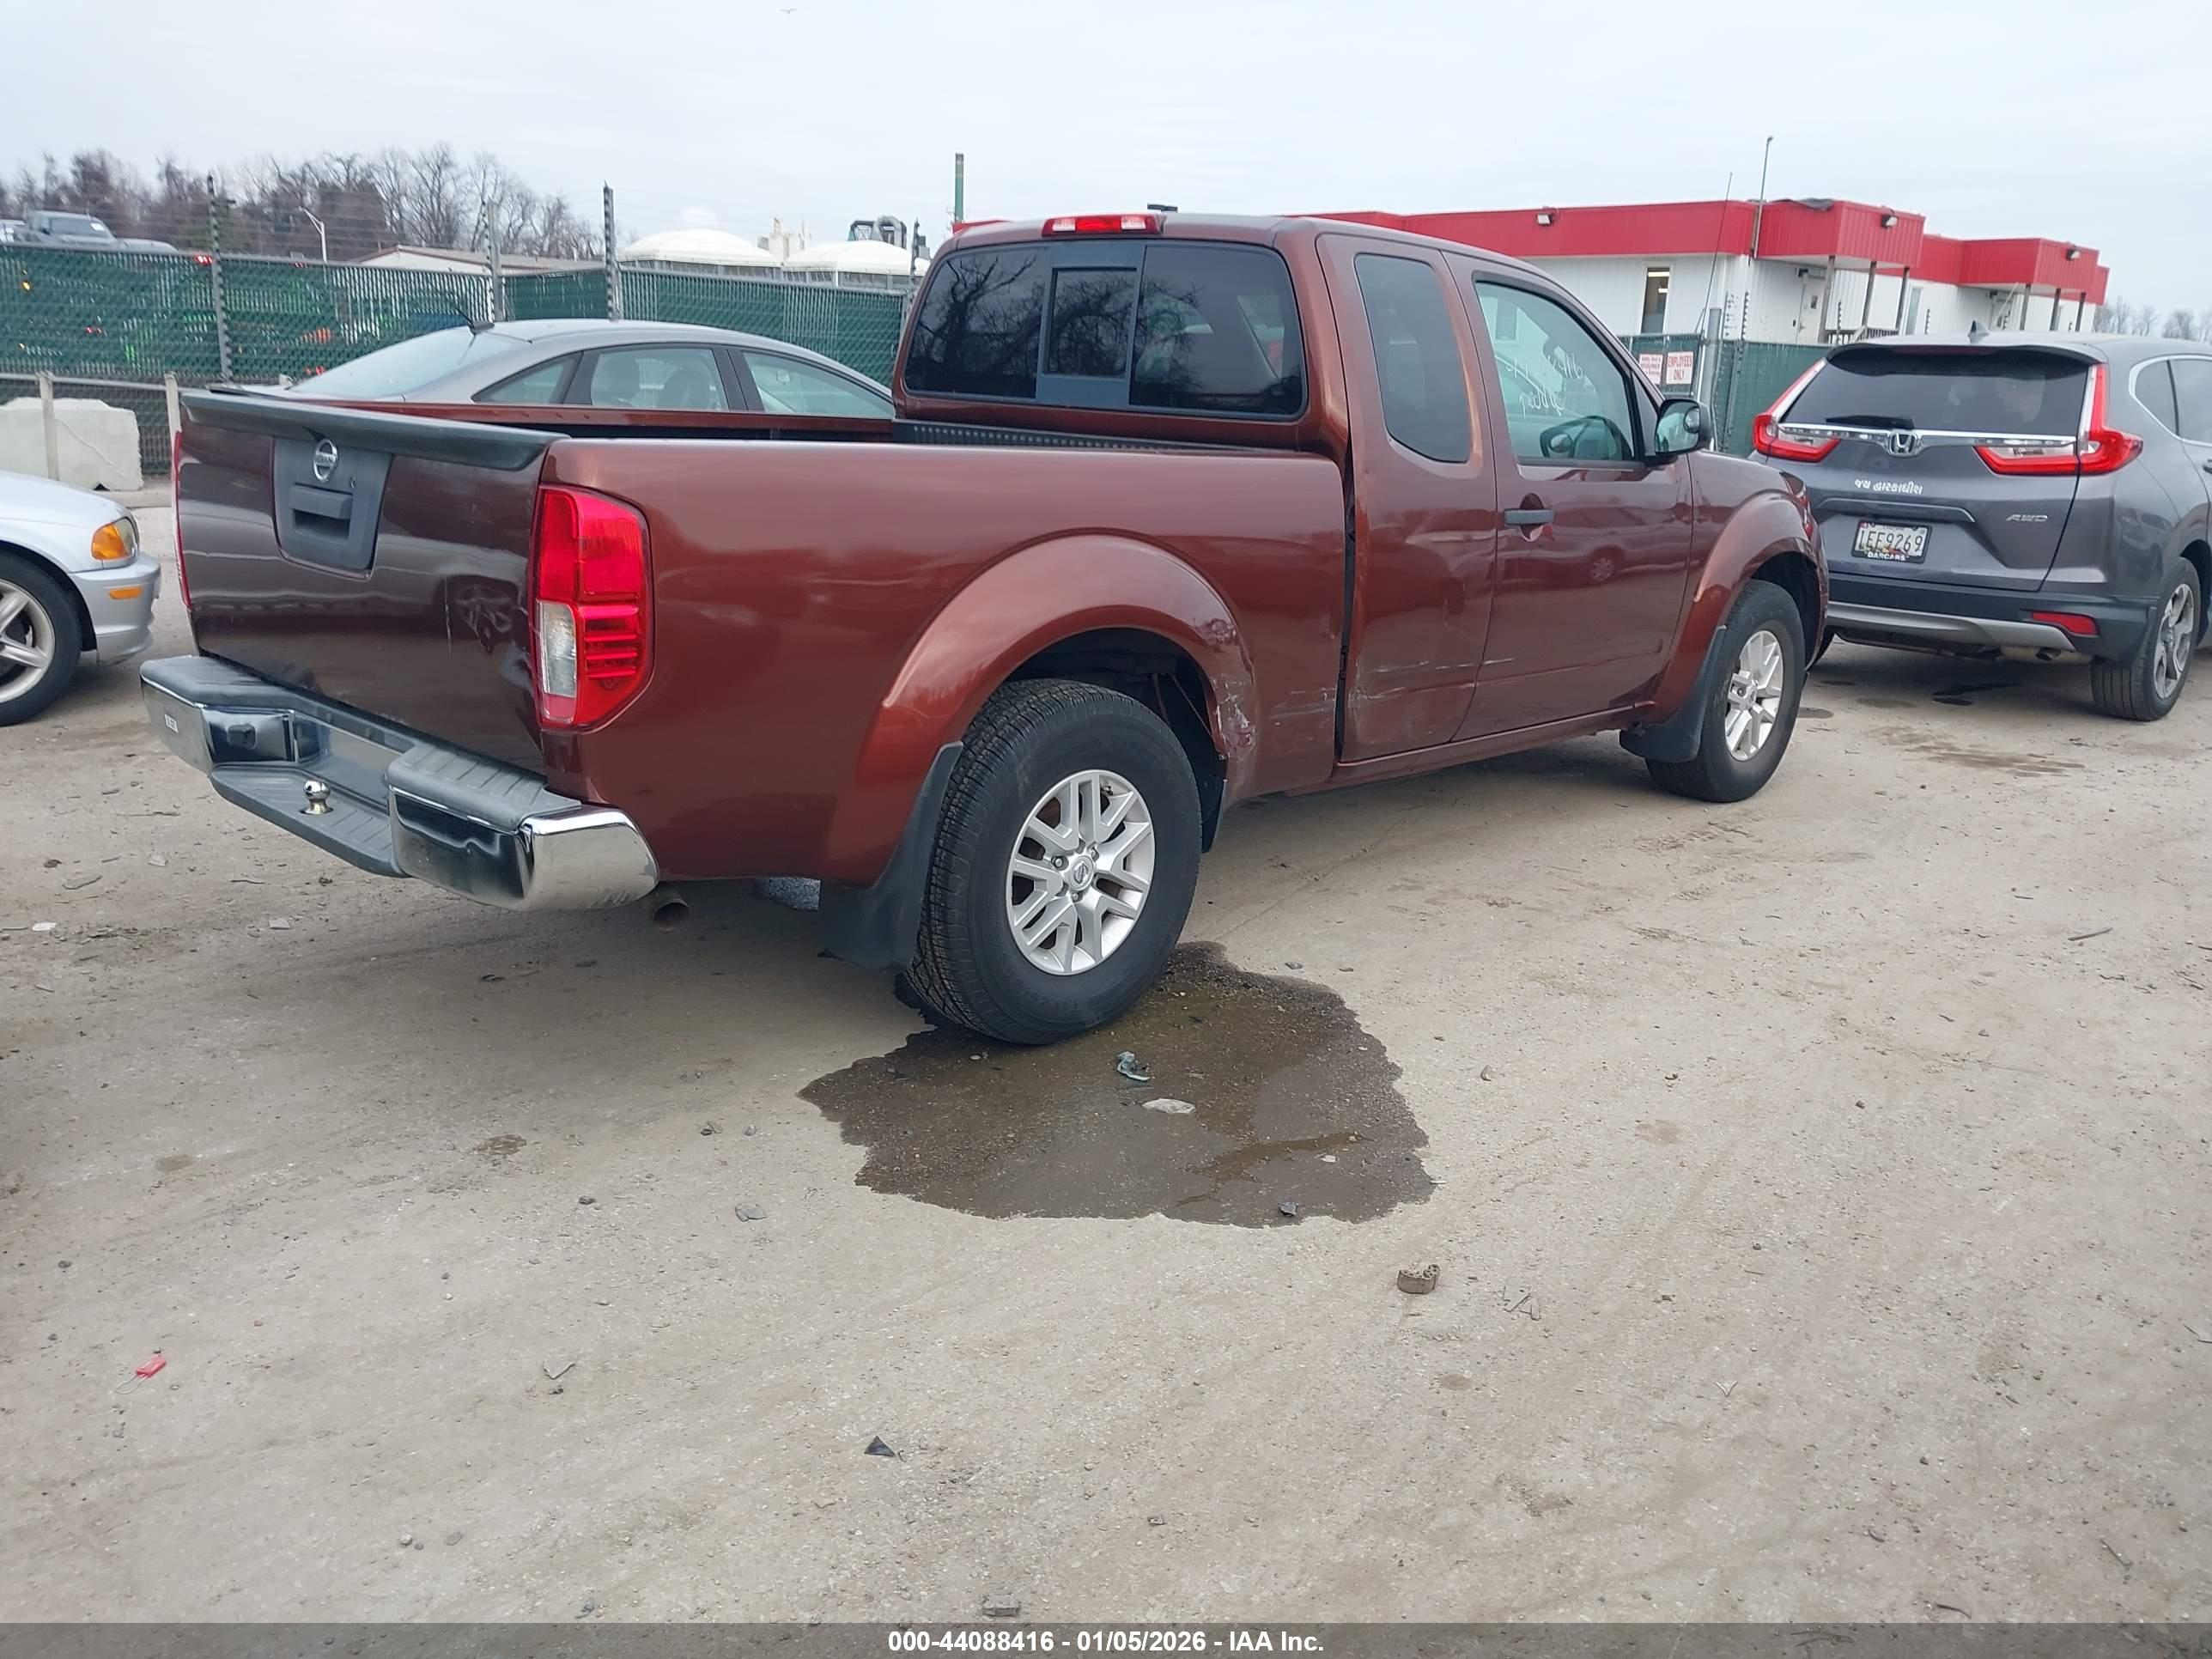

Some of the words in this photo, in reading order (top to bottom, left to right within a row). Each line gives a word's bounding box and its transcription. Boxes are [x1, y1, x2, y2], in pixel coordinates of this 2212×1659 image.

[1668, 355, 1692, 368] EMPLOYEES
[1674, 369, 1685, 380] ONLY
[2006, 514, 2048, 522] AWD
[1867, 551, 1906, 562] DARCARS
